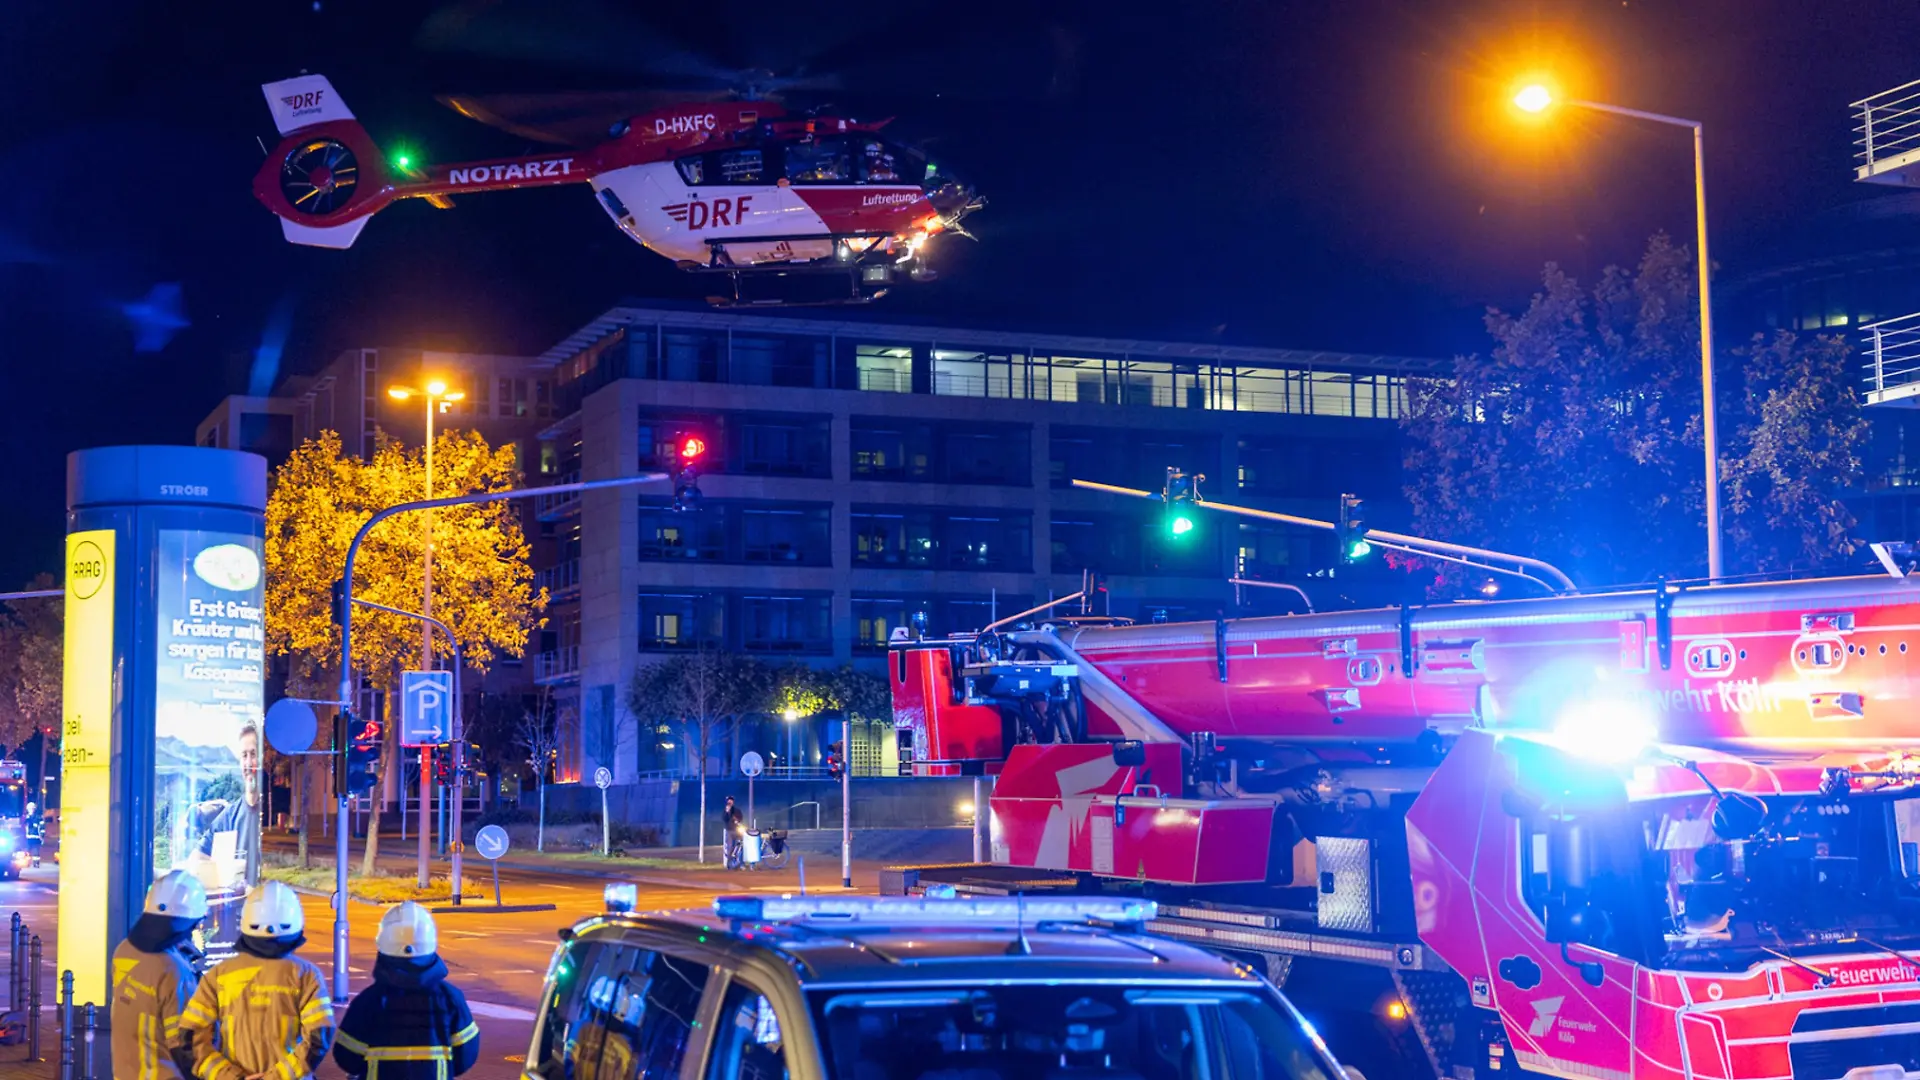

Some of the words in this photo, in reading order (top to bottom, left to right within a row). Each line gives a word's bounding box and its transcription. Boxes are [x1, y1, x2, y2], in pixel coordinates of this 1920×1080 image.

[293, 90, 324, 110] DRF
[655, 113, 716, 135] D-HXFC
[449, 158, 574, 185] NOTARZT
[862, 192, 917, 206] Luftrettung
[688, 195, 752, 231] DRF
[160, 485, 209, 496] STRÖER
[73, 560, 101, 577] ARAG
[189, 599, 225, 617] Erst
[173, 619, 233, 638] Kräuter
[169, 644, 225, 661] sorgen
[418, 690, 439, 720] P
[1716, 677, 1782, 714] Köln
[1830, 960, 1915, 985] Feuerwehr
[1558, 1016, 1597, 1033] Feuerwehr
[1558, 1031, 1575, 1044] Köln
